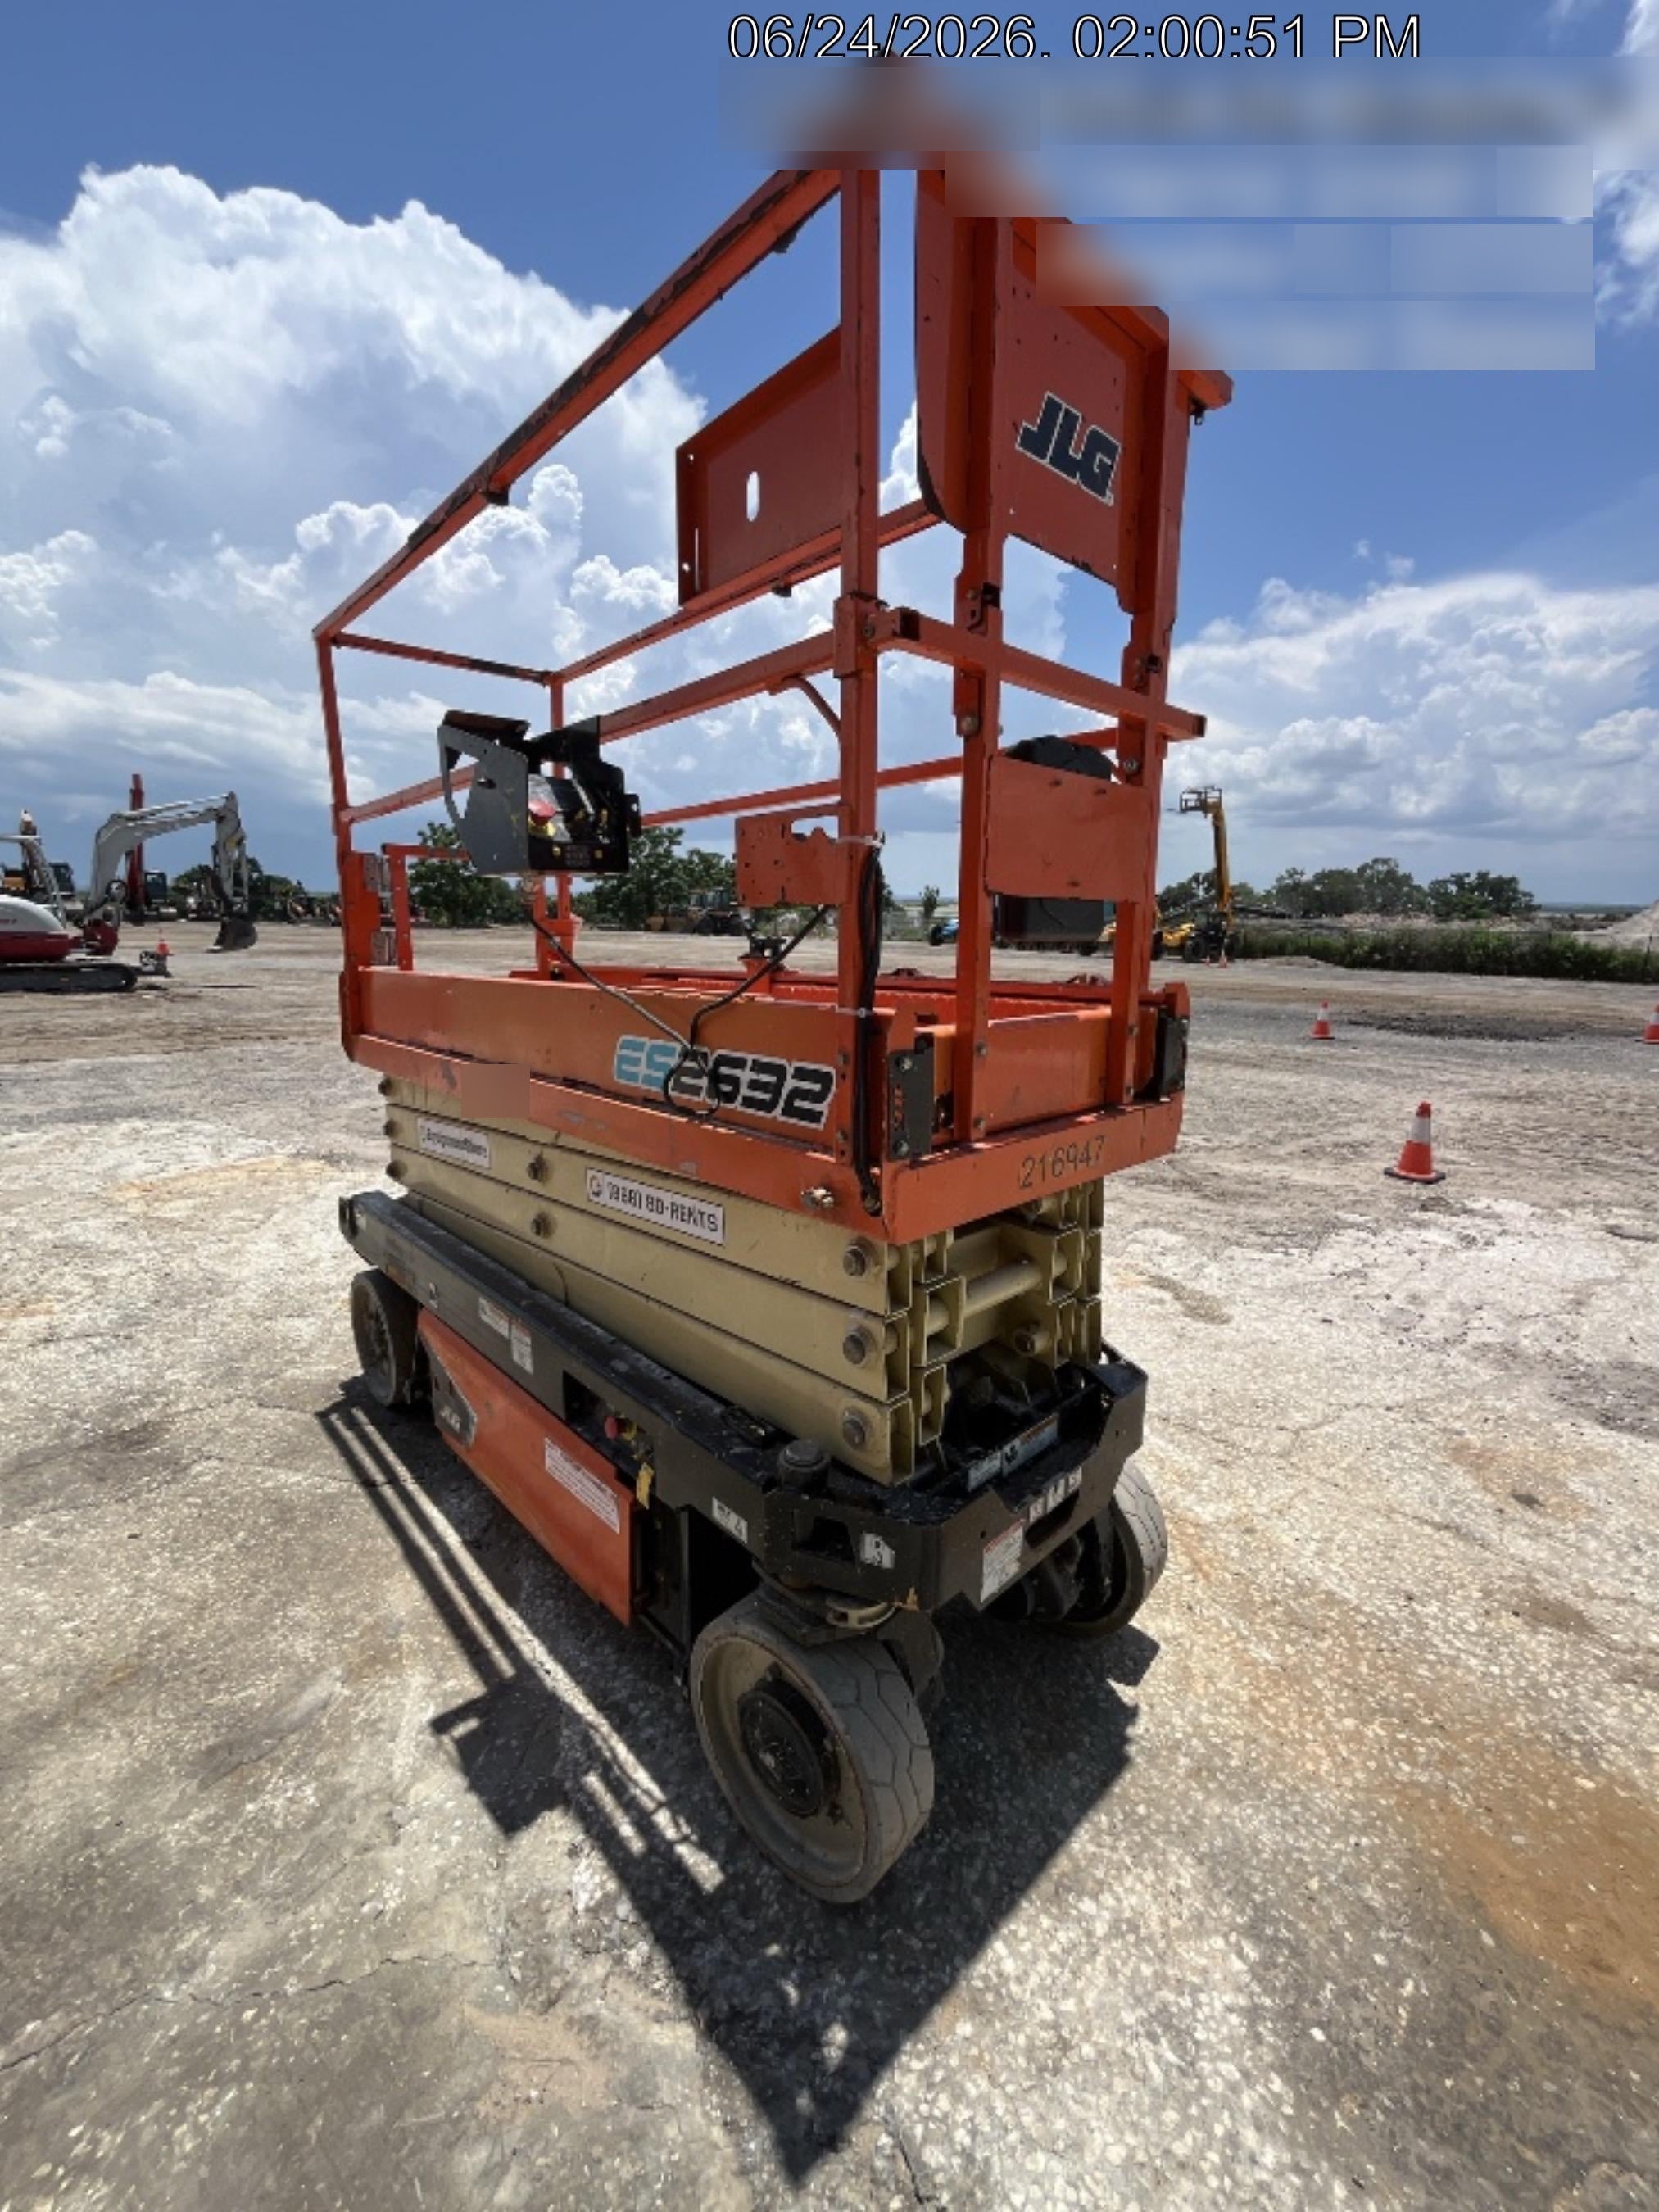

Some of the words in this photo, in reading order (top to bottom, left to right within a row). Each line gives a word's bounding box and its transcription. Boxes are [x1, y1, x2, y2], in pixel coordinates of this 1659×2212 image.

[1015, 391, 1122, 506] JLG
[614, 1036, 836, 1130] ES2632
[1020, 1135, 1106, 1189] 216947
